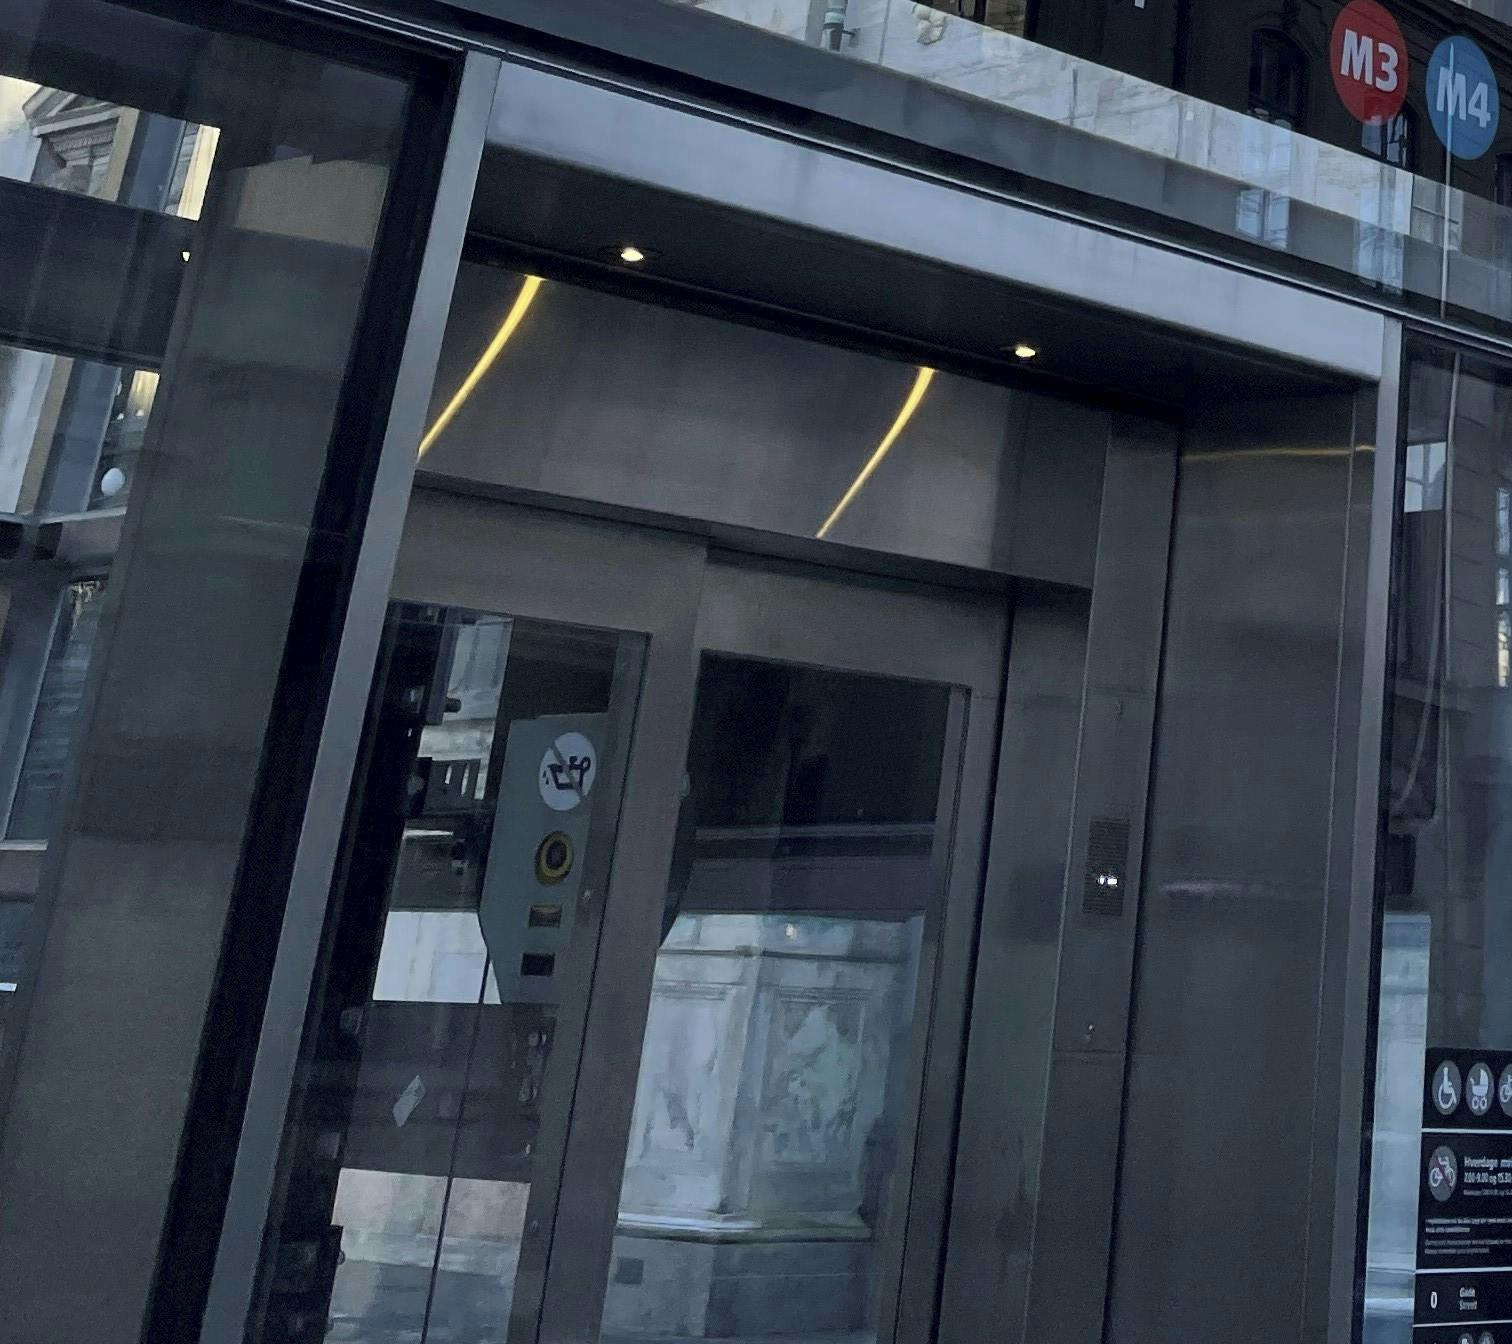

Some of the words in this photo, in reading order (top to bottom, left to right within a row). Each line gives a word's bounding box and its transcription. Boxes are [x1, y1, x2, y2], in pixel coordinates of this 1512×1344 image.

[1340, 28, 1399, 92] M3
[1436, 66, 1492, 129] M4
[1430, 1291, 1438, 1309] 0
